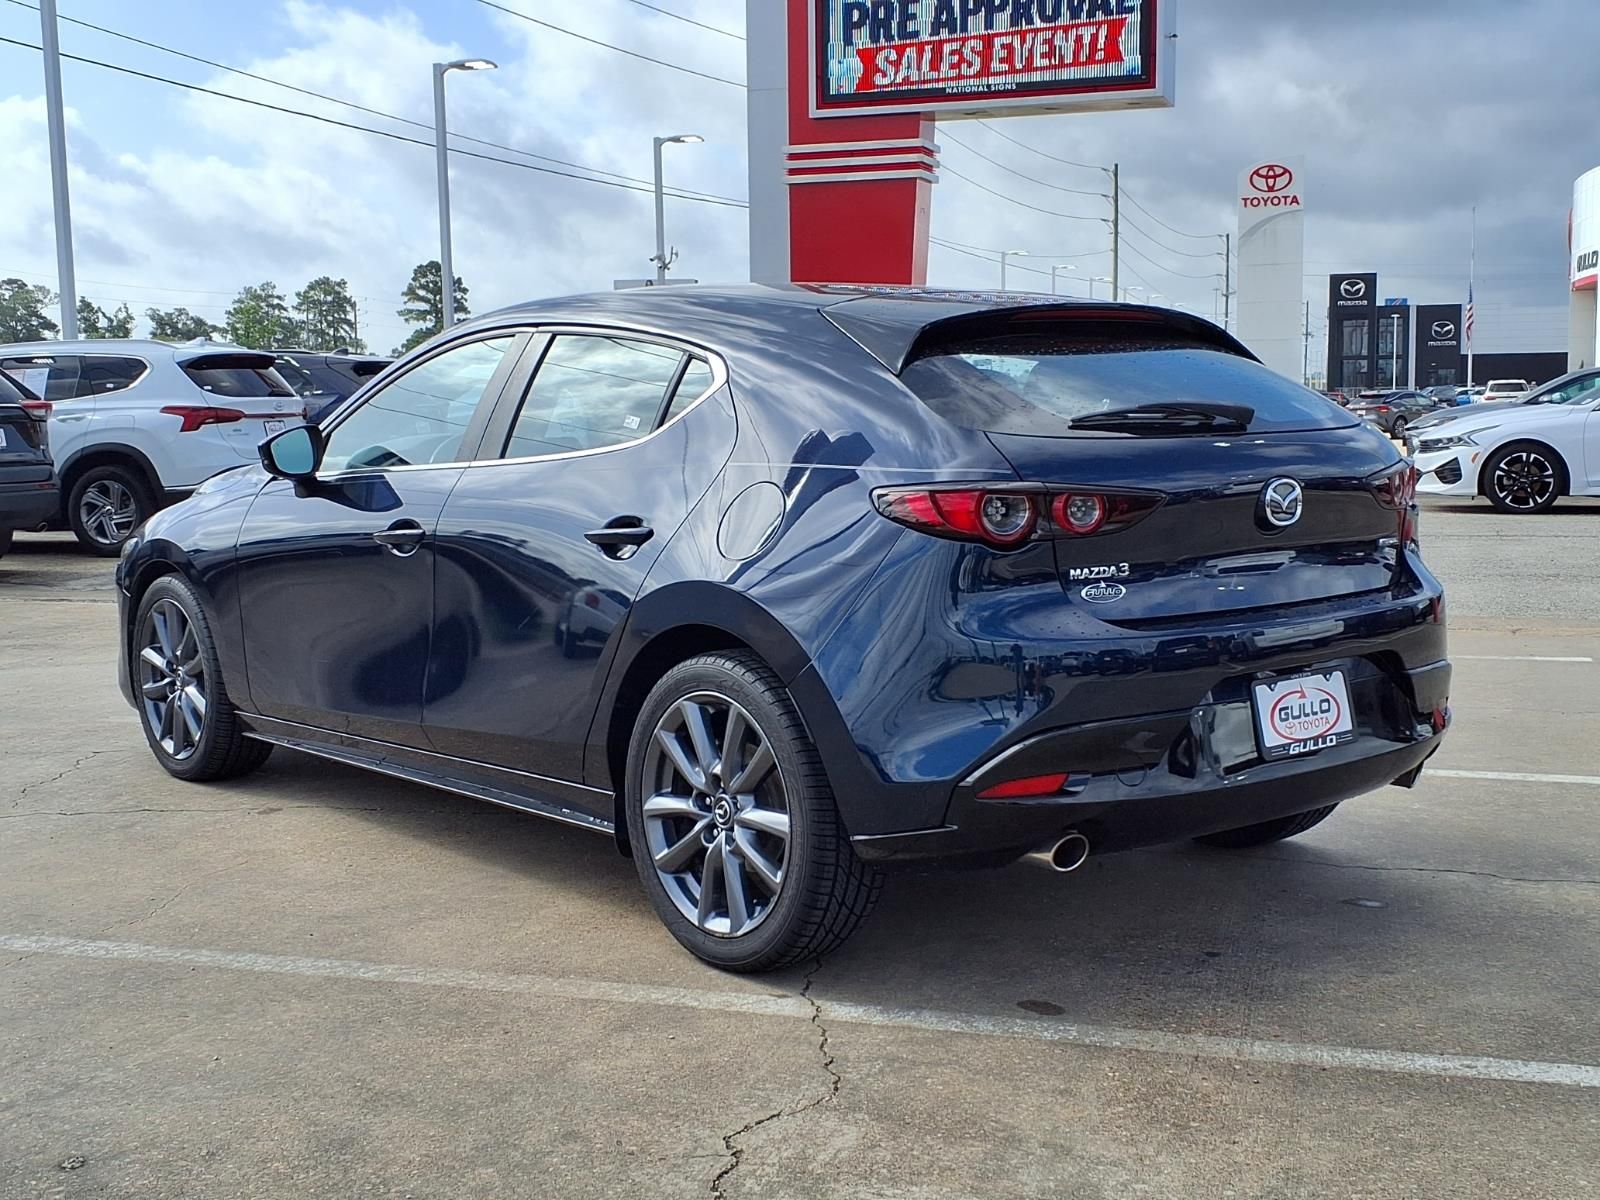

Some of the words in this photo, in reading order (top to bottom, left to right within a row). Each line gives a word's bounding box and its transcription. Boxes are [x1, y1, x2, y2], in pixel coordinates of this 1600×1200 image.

[843, 0, 920, 47] PRE
[874, 39, 983, 85] SALES
[991, 24, 1107, 73] EVENT!
[946, 85, 988, 94] NATIONAL
[990, 83, 1017, 92] SIGNS
[1241, 195, 1300, 208] TOYOTA
[1278, 698, 1331, 722] GULLO
[1298, 716, 1331, 731] TOYOTA
[1289, 735, 1336, 754] GULLO
